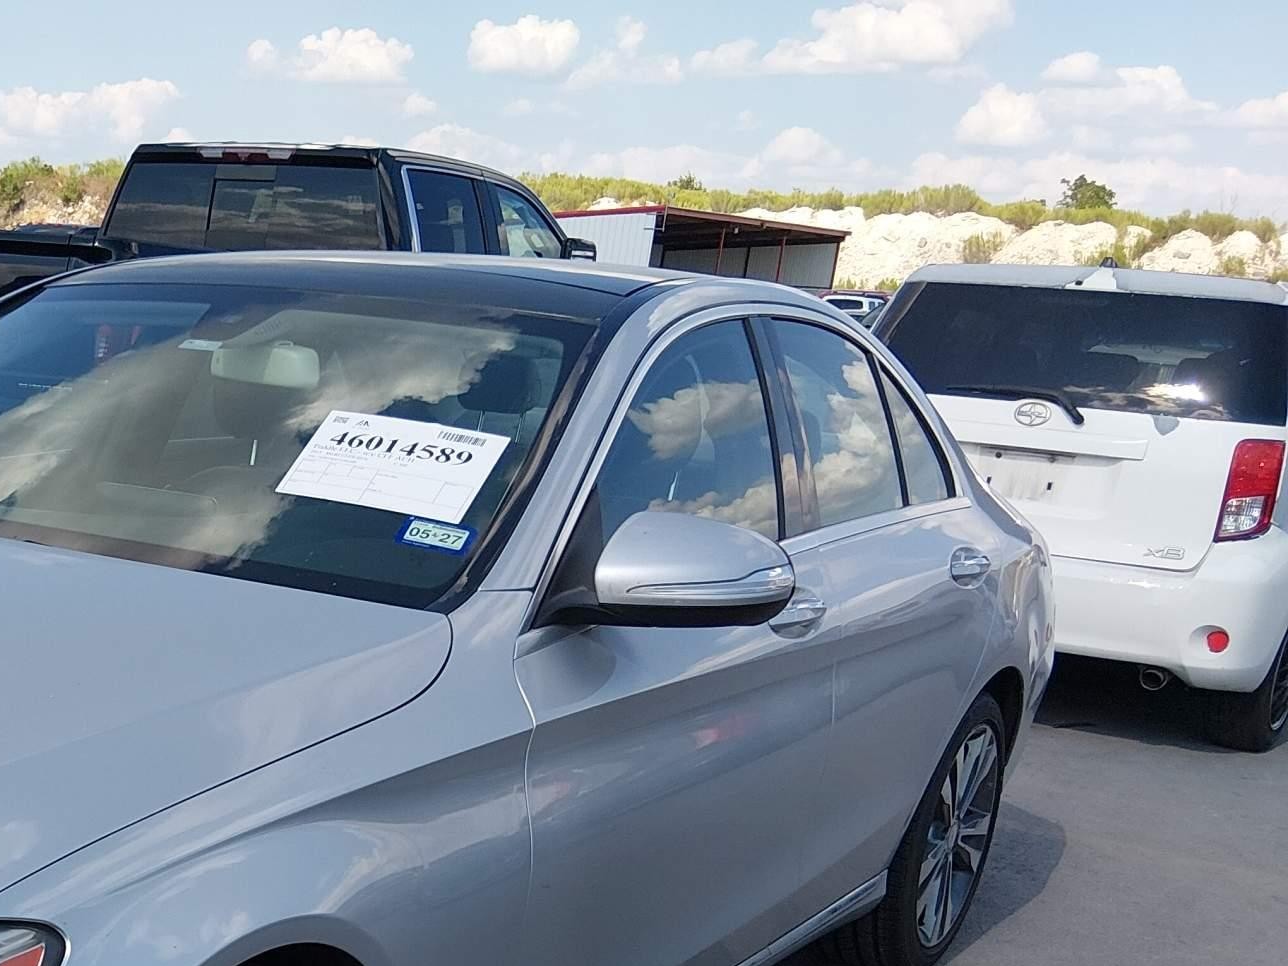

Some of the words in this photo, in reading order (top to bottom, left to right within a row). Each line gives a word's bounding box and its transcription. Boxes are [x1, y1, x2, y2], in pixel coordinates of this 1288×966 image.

[330, 431, 473, 466] 46014589
[408, 526, 432, 539] 05
[438, 532, 463, 545] 27
